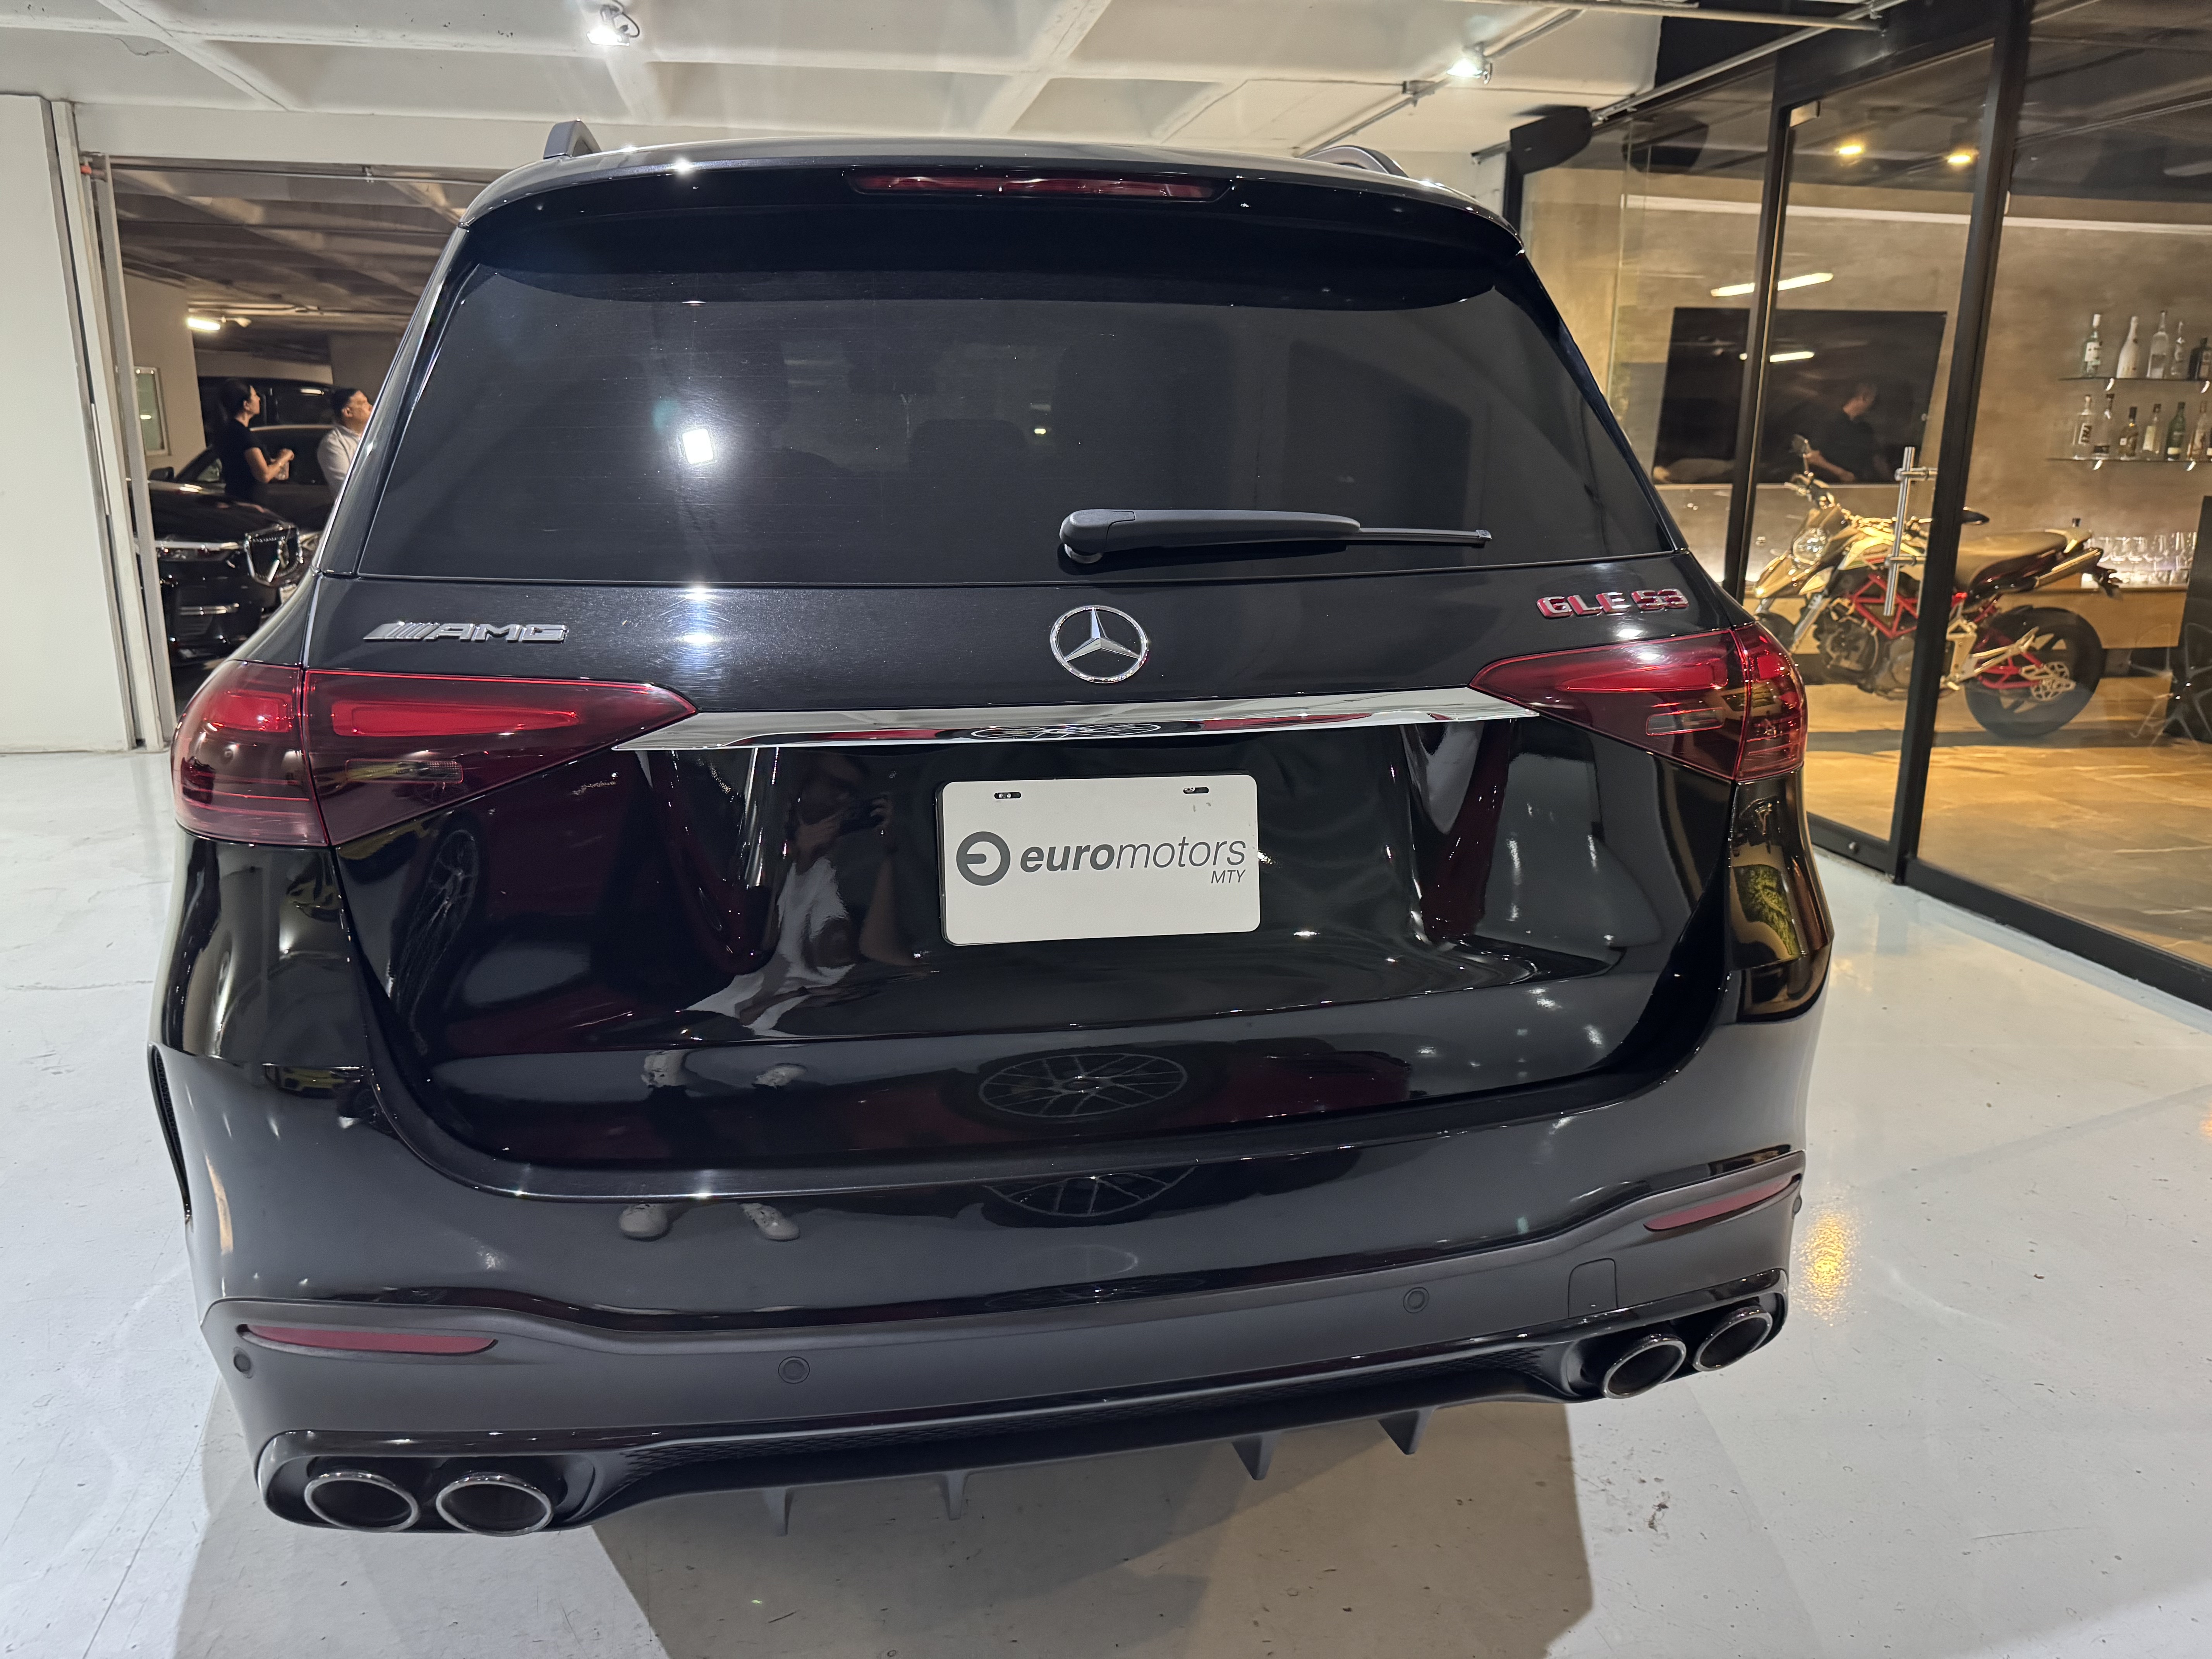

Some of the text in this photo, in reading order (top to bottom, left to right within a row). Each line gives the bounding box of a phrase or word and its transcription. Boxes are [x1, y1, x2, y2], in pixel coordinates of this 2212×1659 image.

[1536, 588, 1689, 620] GLE 53
[423, 622, 569, 643] AMG
[1020, 836, 1246, 873] euromotors
[1211, 869, 1246, 884] MTY
